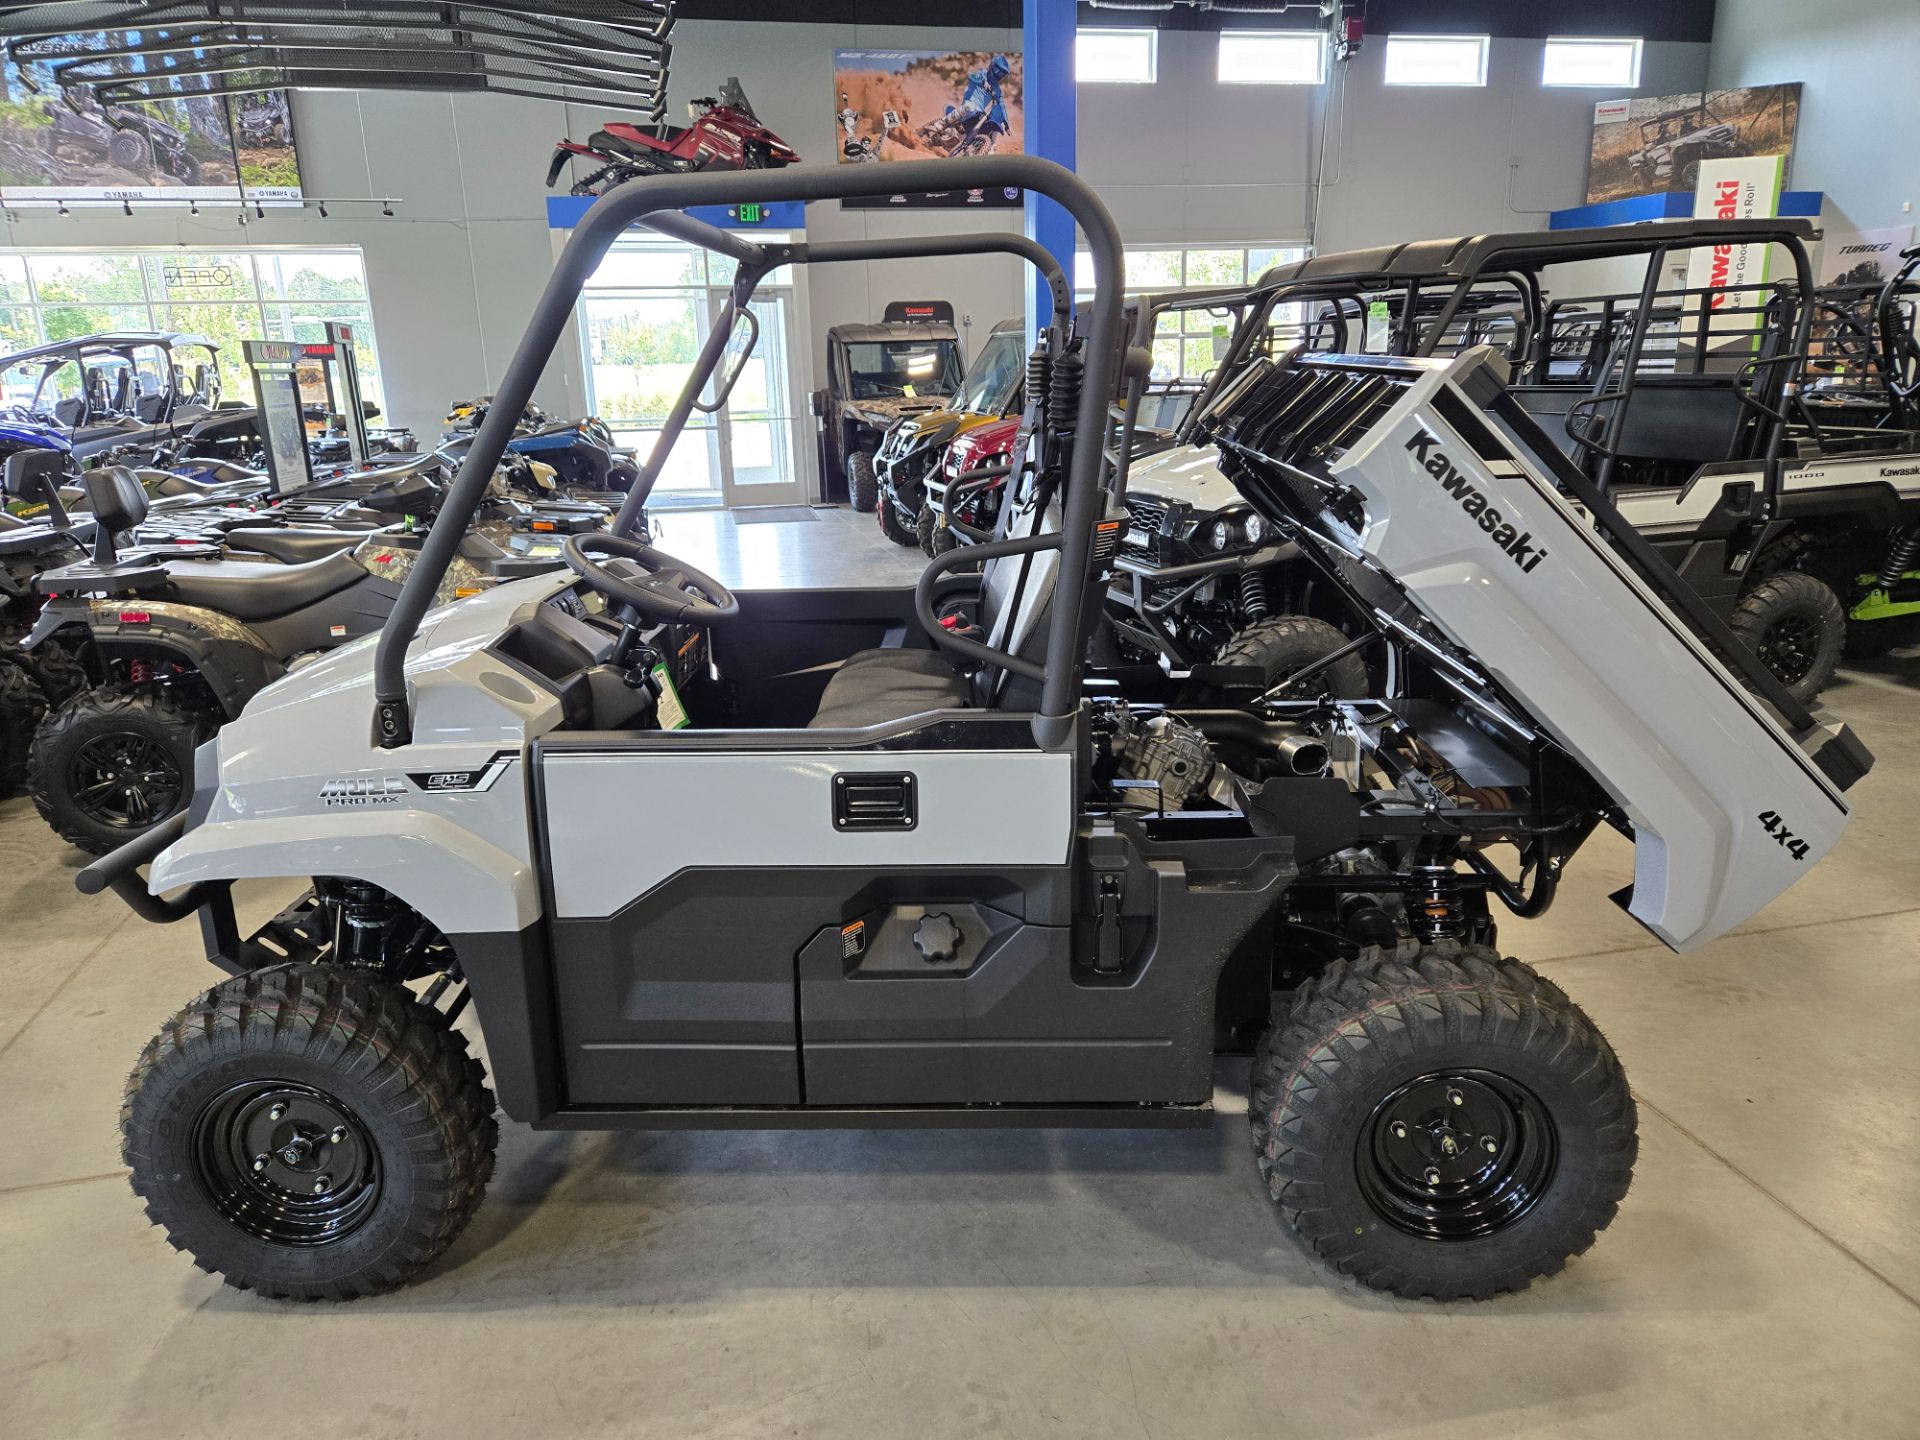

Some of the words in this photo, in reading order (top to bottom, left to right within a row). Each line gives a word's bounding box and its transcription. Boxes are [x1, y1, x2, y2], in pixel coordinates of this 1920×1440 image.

[112, 191, 143, 199] YAMAHA
[740, 204, 760, 221] EXIT
[1404, 427, 1549, 574] Kawasaki
[319, 776, 409, 798] MULE
[427, 773, 471, 788] EPS
[326, 798, 369, 807] PRO
[371, 796, 401, 805] MX
[1757, 810, 1811, 861] 4x4
